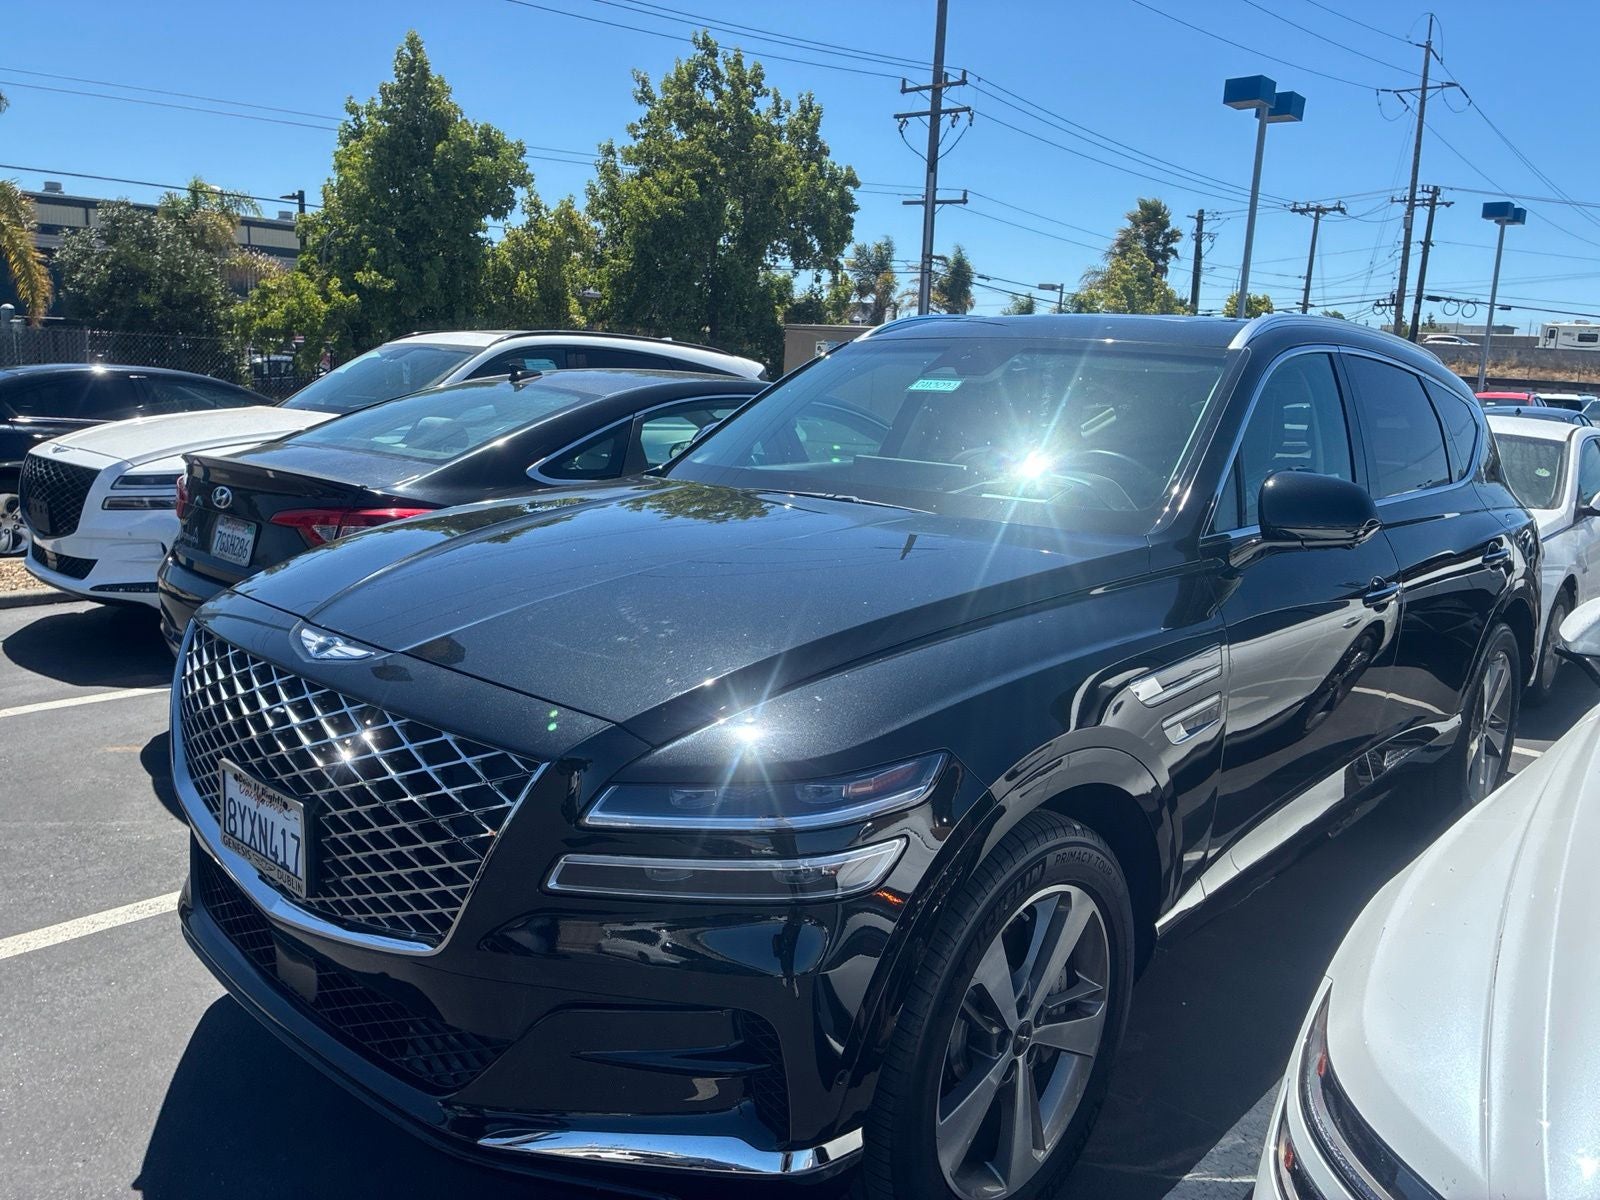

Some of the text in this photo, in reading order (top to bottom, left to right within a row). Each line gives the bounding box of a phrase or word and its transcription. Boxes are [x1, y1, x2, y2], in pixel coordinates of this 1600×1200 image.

[222, 834, 303, 895] GENESIS DUBLIN
[227, 796, 301, 876] 8YXN417
[1054, 851, 1093, 866] PRIMACY
